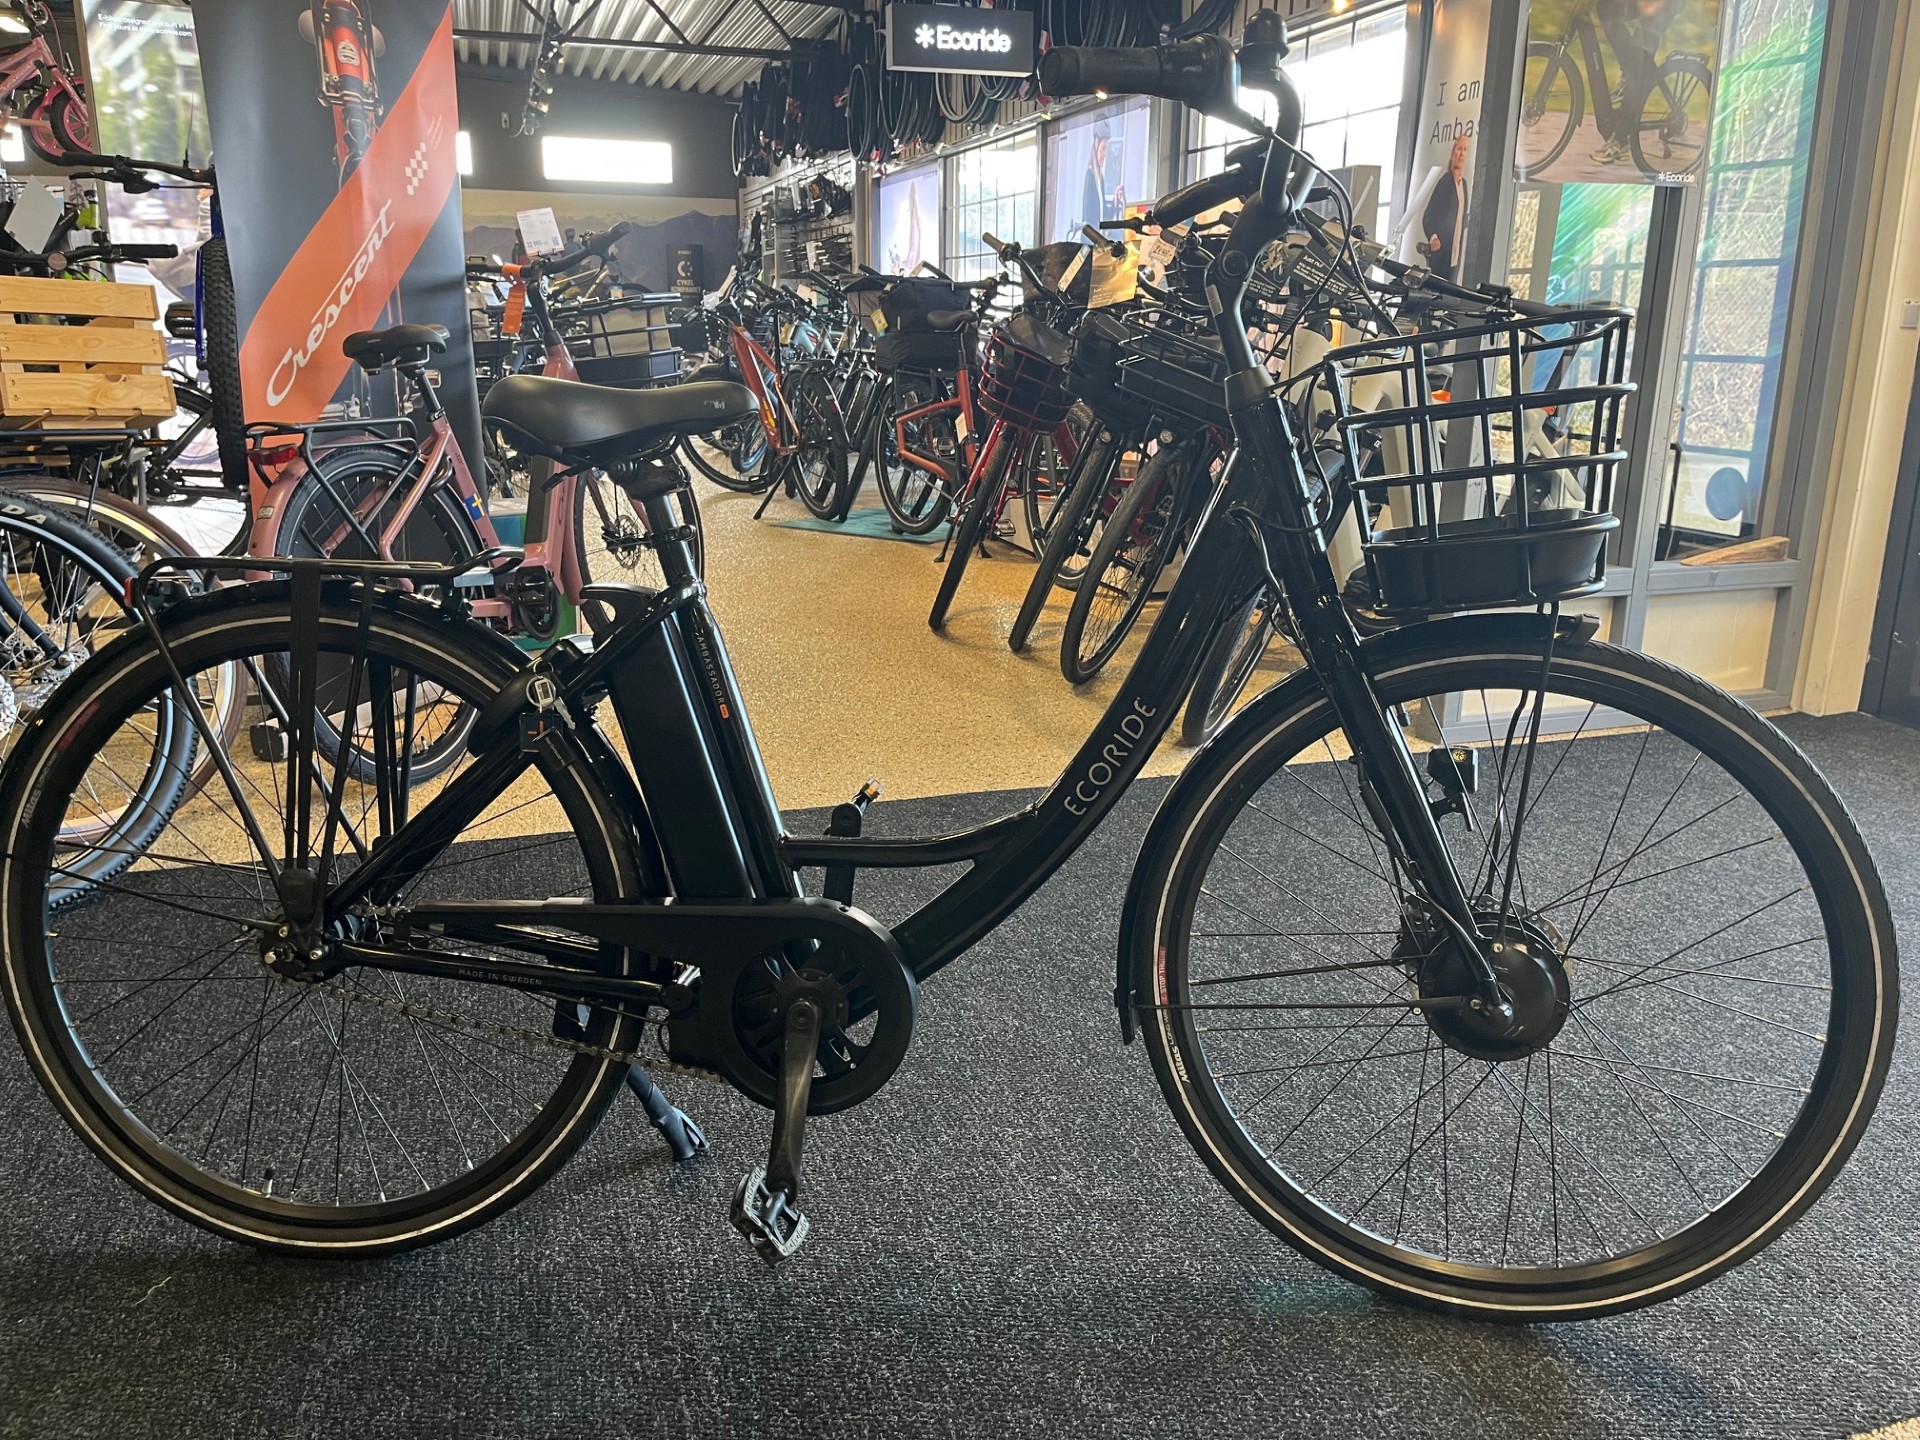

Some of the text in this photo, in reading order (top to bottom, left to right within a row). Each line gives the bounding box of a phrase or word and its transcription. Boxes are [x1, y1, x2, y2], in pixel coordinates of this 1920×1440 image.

[936, 24, 1012, 53] Ecoride
[1436, 79, 1481, 107] I am
[1429, 116, 1480, 145] Amba
[1665, 171, 1696, 183] Ecoride
[266, 198, 395, 407] Crescent
[697, 635, 725, 704] AMBASSADOR
[1063, 696, 1157, 816] ECORIDE
[458, 968, 543, 986] MADE IN SWEDEN
